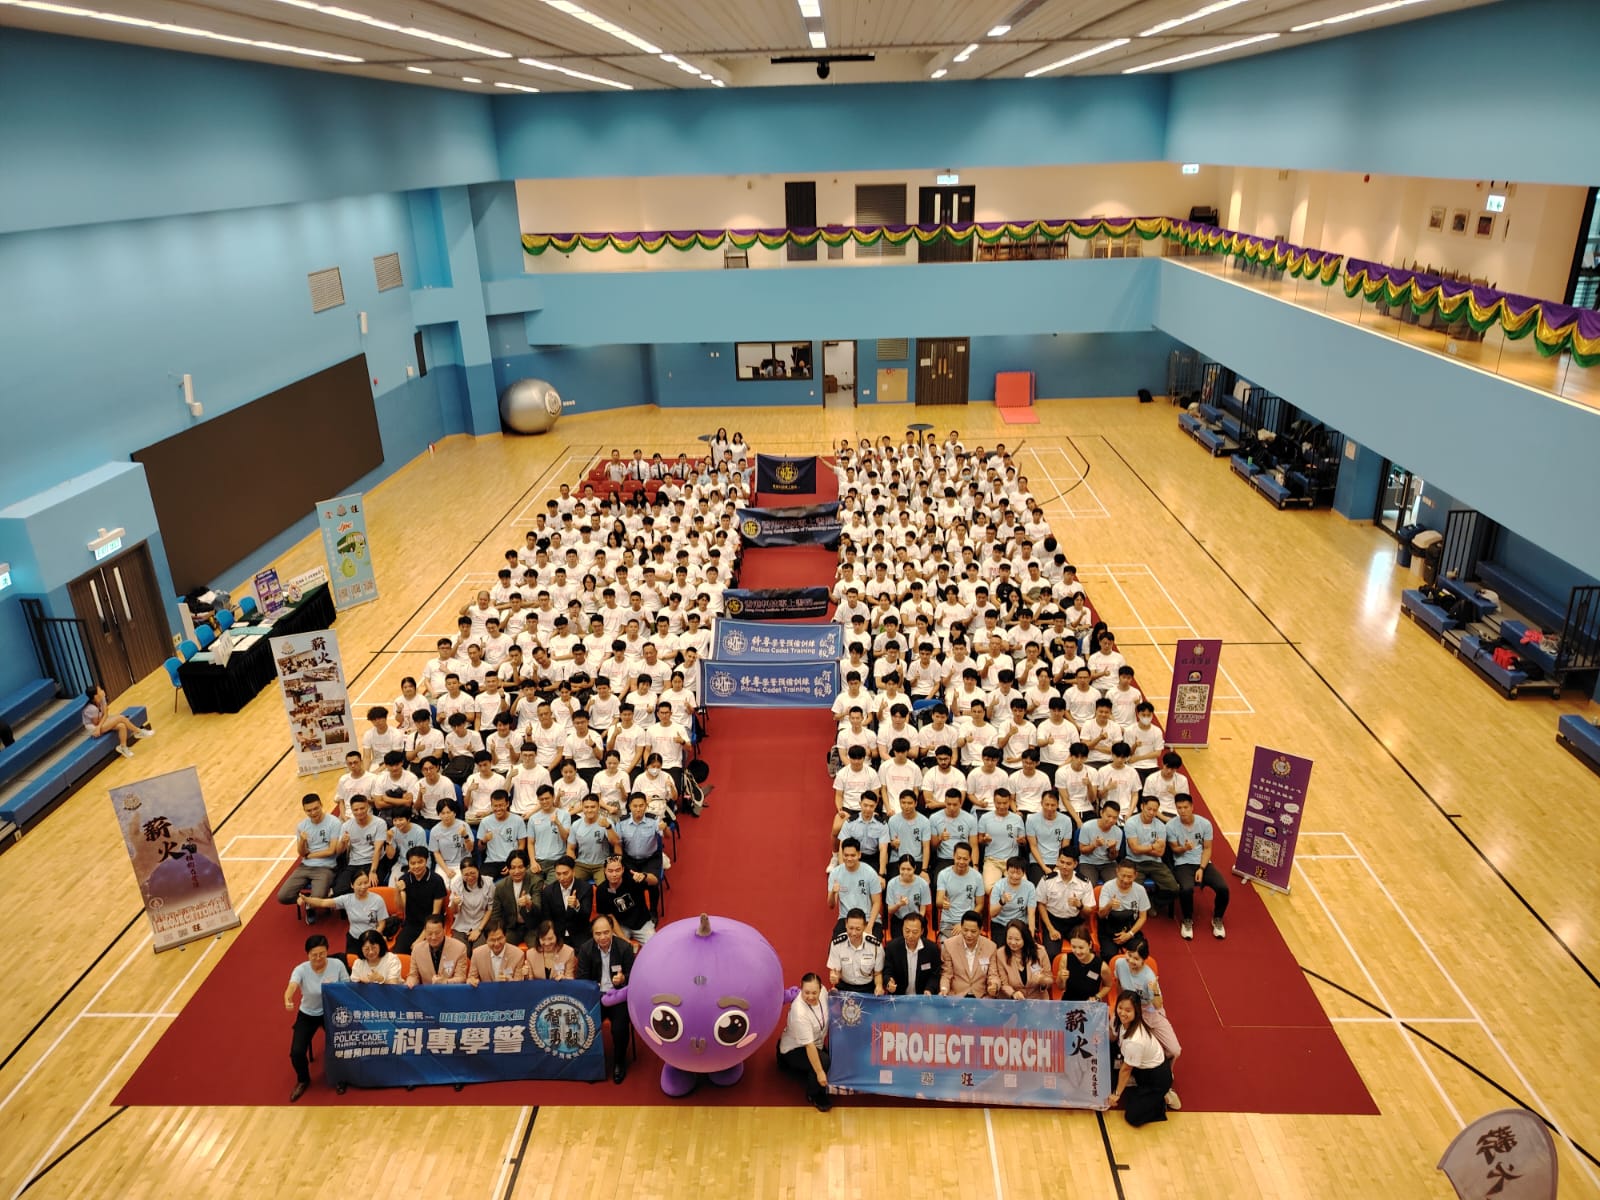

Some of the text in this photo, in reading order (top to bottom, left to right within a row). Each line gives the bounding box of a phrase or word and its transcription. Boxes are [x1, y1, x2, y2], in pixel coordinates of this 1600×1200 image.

[783, 685, 811, 693] Training
[143, 816, 186, 863] 薪火
[353, 1010, 424, 1020] 香港科技專上書院
[333, 1033, 361, 1044] POLICE
[361, 1032, 388, 1042] CADET
[391, 1026, 526, 1056] 科專學警
[1065, 1009, 1094, 1059] 薪火
[882, 1031, 1051, 1068] PROJECT TORCH
